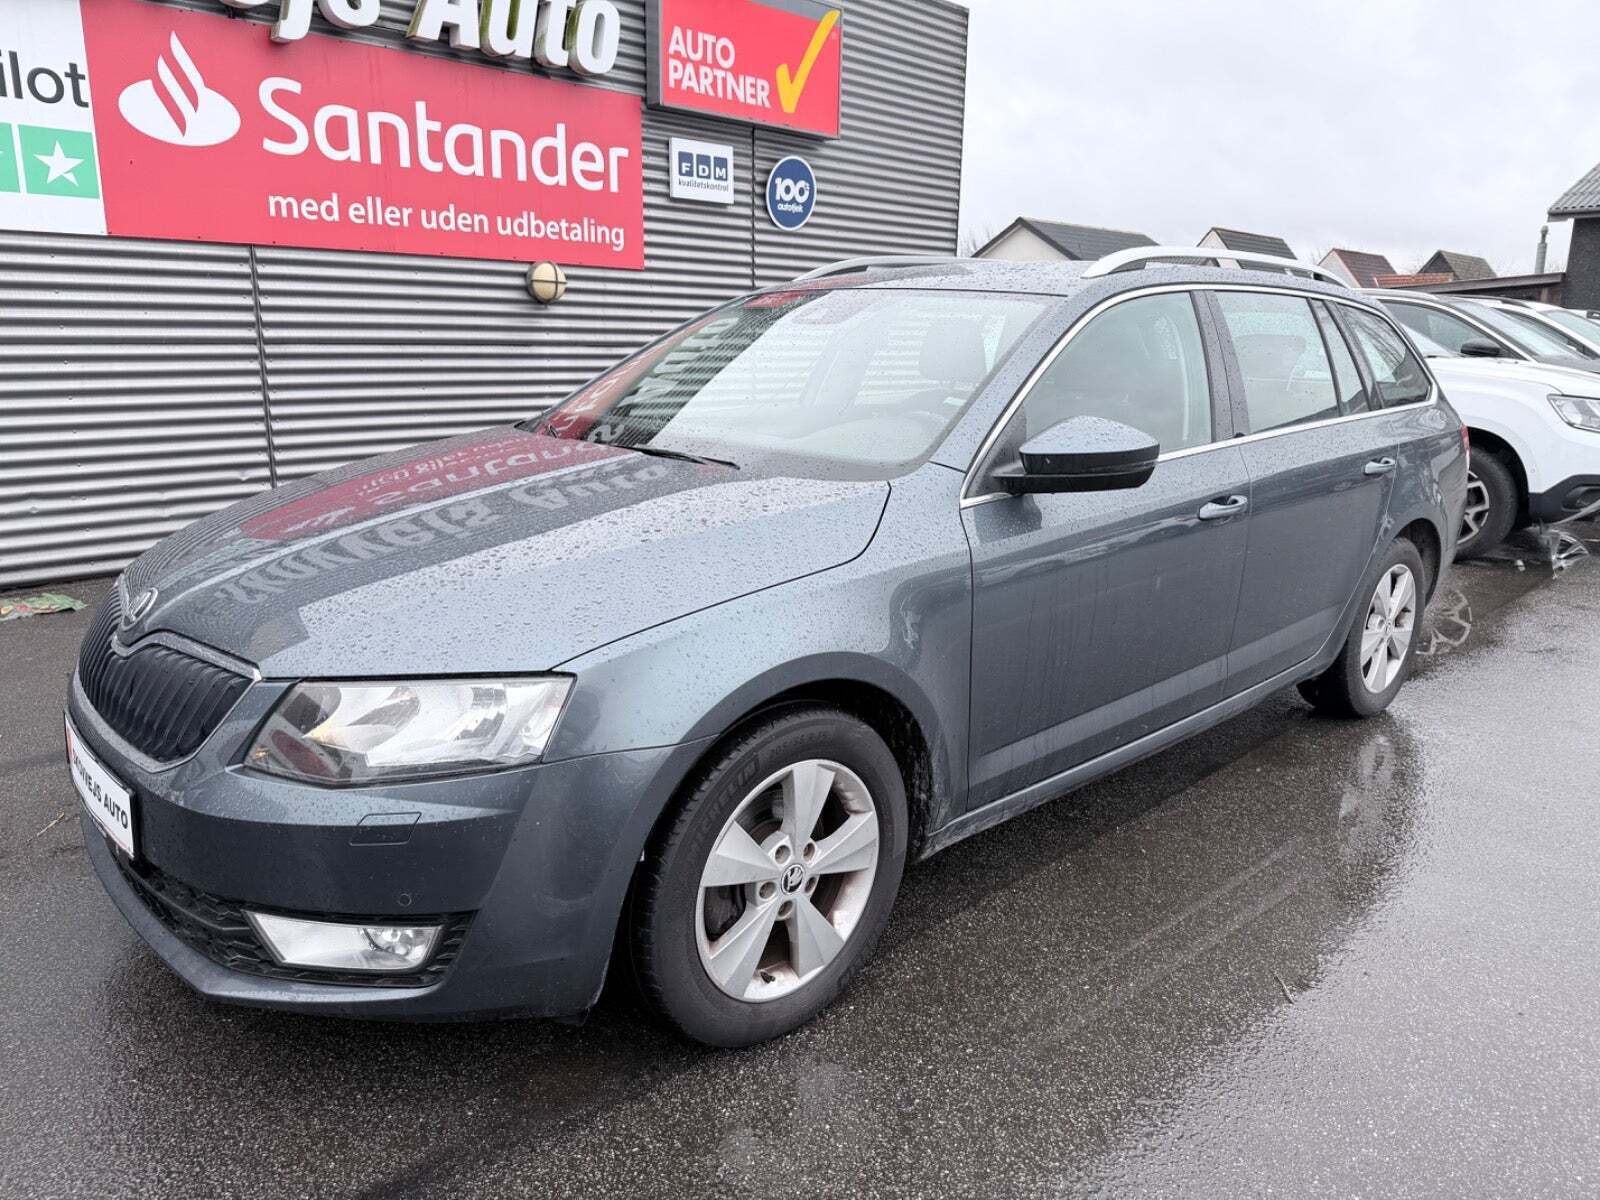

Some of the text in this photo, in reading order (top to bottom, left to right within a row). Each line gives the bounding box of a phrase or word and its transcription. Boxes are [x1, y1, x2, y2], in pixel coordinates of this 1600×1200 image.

[669, 25, 735, 69] AUTO
[669, 57, 771, 109] PARTNER
[259, 76, 629, 193] Santander
[681, 161, 727, 179] FDM
[268, 193, 625, 251] med eller uden udbetaling
[104, 793, 129, 830] AUTO
